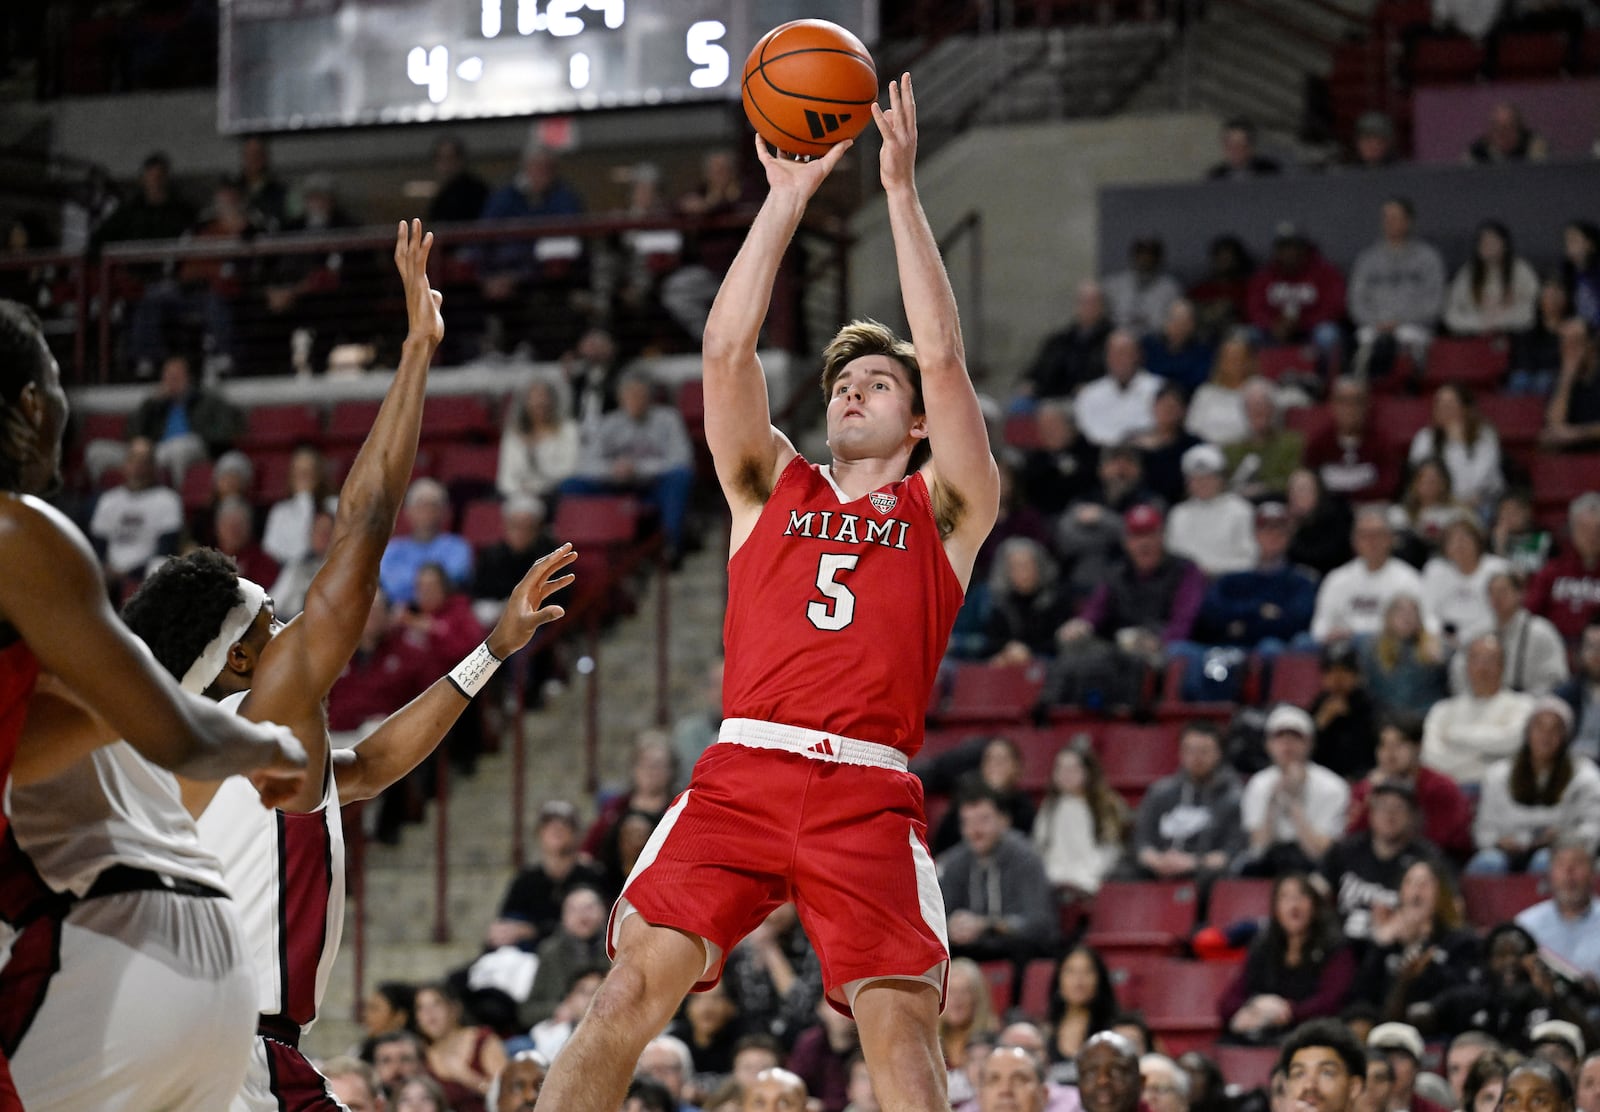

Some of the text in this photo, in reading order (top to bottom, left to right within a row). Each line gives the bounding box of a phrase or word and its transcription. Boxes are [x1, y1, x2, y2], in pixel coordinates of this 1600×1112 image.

[686, 20, 729, 88] 5
[784, 510, 911, 550] MIAMI
[806, 553, 860, 631] 5
